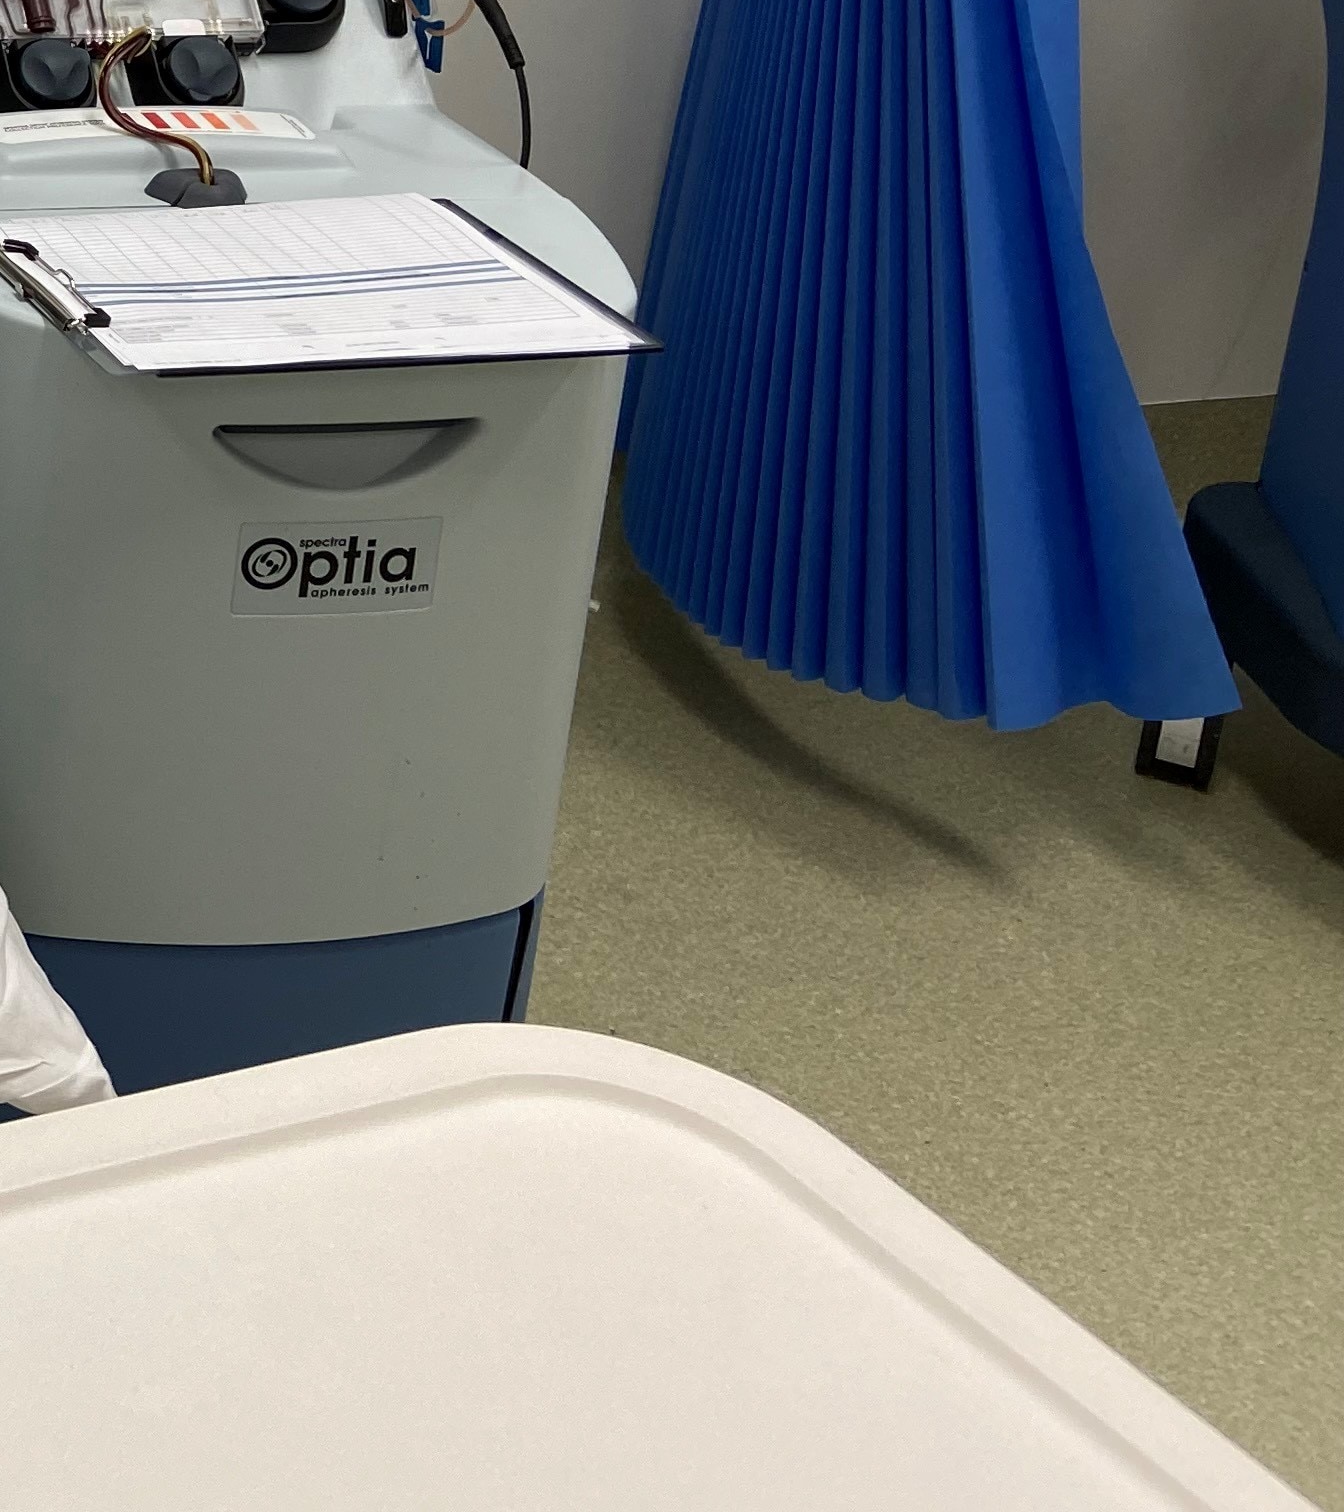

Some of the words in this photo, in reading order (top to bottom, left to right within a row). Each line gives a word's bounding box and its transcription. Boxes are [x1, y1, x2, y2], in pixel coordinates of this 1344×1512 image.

[299, 537, 347, 548] spectra
[241, 536, 417, 598] Optia
[311, 585, 377, 599] apheresis
[384, 583, 429, 595] system
